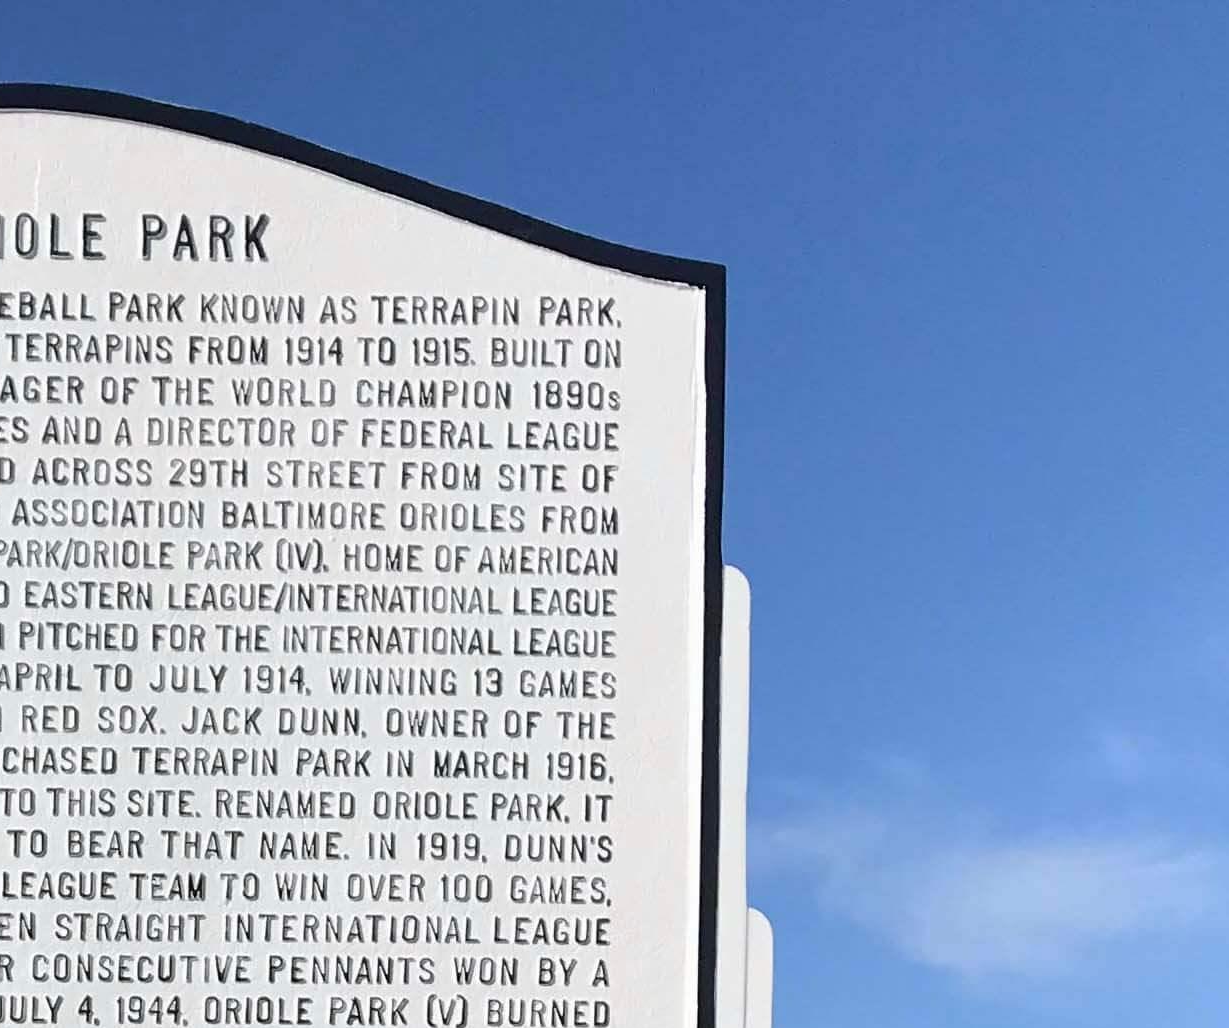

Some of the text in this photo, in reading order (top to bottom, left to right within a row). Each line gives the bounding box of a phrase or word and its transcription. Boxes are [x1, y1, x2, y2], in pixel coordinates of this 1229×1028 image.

[141, 213, 270, 263] PARK
[108, 291, 186, 323] PARK
[200, 293, 305, 325] KNOWN
[319, 295, 357, 325] AS
[370, 295, 520, 326] TERRAPIN
[539, 296, 622, 329] PARK,
[100, 376, 140, 406] OF
[151, 375, 215, 407] THE
[231, 376, 336, 408] WORLD
[356, 379, 512, 410] CHAMPION
[533, 379, 621, 412] 1890s
[31, 457, 153, 487] ACROSS
[168, 458, 249, 488] 29TH
[266, 459, 387, 490] STREET
[401, 461, 481, 491] FROM
[498, 463, 567, 493] SITE
[581, 463, 617, 494] OF
[24, 580, 153, 611] EASTERN
[168, 581, 503, 615] LEAGUE/INTERNATIONAL
[513, 587, 618, 618] LEAGUE
[92, 663, 133, 693] TO
[149, 664, 228, 694] JULY
[243, 664, 312, 697] 1914,
[329, 666, 457, 697] WINNING
[474, 667, 503, 698] 13
[519, 669, 617, 700] GAMES
[6, 829, 48, 859] TO
[67, 829, 145, 859] BEAR
[160, 829, 245, 861] THAT
[259, 831, 350, 861] NAME.
[368, 831, 397, 861] IN
[417, 832, 488, 864] 1919,
[504, 833, 613, 864] DUNN'S
[54, 912, 207, 943] STRAIGHT
[224, 913, 481, 945] INTERNATIONAL
[493, 915, 611, 947] LEAGUE
[77, 994, 101, 1027] 4,
[116, 995, 189, 1027] 1944,
[204, 995, 314, 1026] ORIOLE
[328, 996, 410, 1027] PARK
[487, 998, 611, 1028] BURNED
